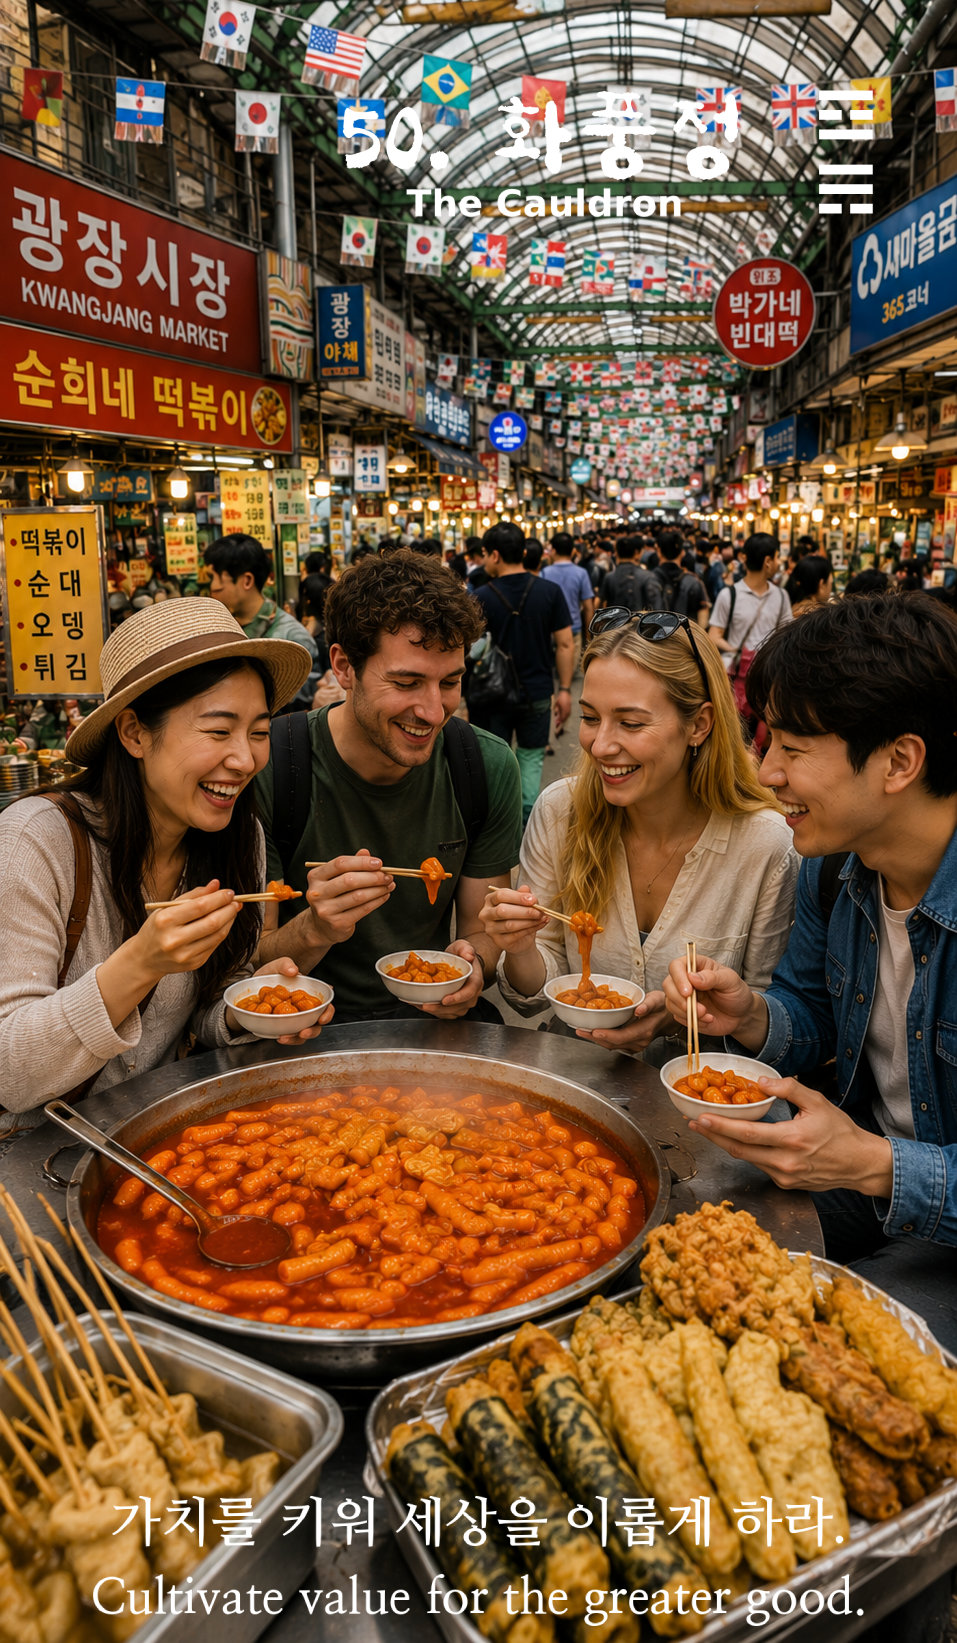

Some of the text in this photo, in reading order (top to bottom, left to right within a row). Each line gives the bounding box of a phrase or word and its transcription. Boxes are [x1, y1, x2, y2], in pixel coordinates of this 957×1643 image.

[11, 186, 231, 320] 광장시장
[20, 277, 229, 353] KWANGJANG MARKET
[729, 288, 801, 319] 박가네
[730, 320, 799, 349] 빈대떡
[12, 349, 247, 437] 순희네 떡볶이
[20, 527, 86, 557] 떡볶이
